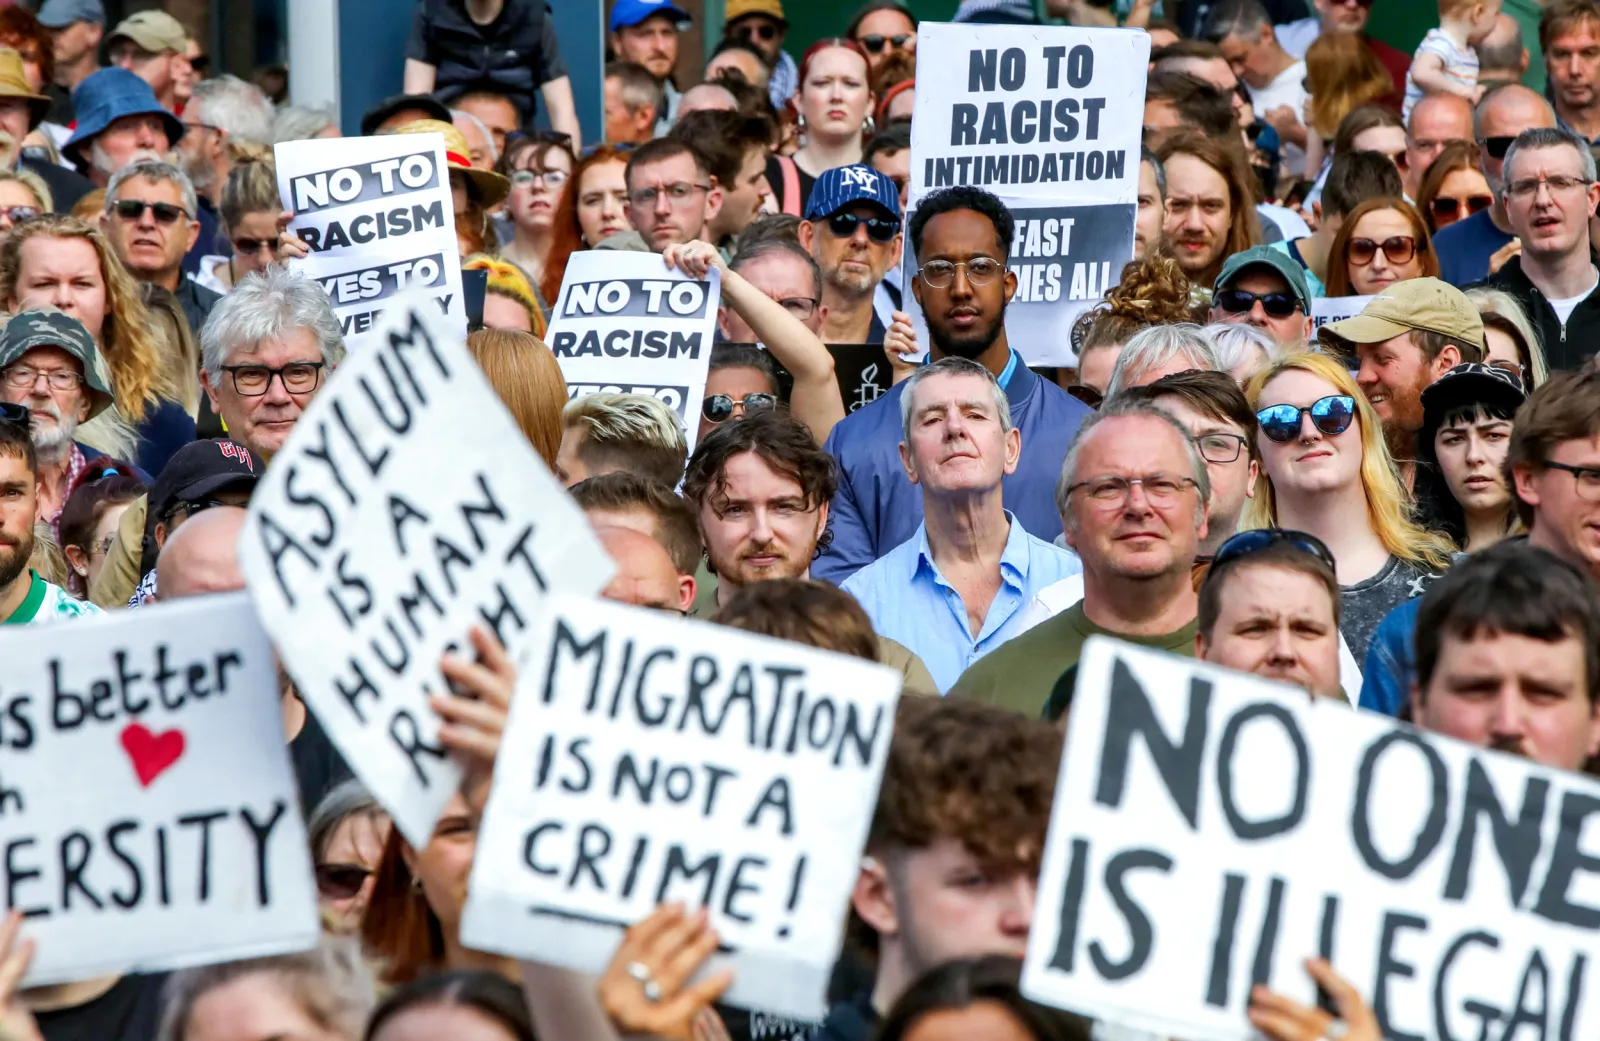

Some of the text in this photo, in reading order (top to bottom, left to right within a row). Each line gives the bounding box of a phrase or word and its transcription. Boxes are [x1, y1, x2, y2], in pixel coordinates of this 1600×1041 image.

[968, 44, 1094, 93] NO TO
[950, 97, 1106, 146] RACIST
[295, 154, 433, 211] NO TO
[840, 166, 879, 194] NY
[924, 149, 1126, 188] INTIMIDATION
[296, 200, 445, 253] RACISM
[1009, 218, 1075, 258] FAST
[565, 280, 704, 315] NO TO
[1069, 261, 1111, 301] ALL
[552, 329, 703, 360] RACISM
[257, 307, 453, 606] ASYLUM
[326, 495, 430, 631] IS A
[332, 472, 506, 725] HUMAN
[48, 645, 244, 730] better
[389, 524, 549, 789] RHT
[542, 617, 884, 767] MIGRATION
[535, 735, 793, 836] IS NOT A
[1095, 656, 1600, 931] NO ONE
[523, 822, 807, 937] CRIME!
[1047, 838, 1176, 982] IS
